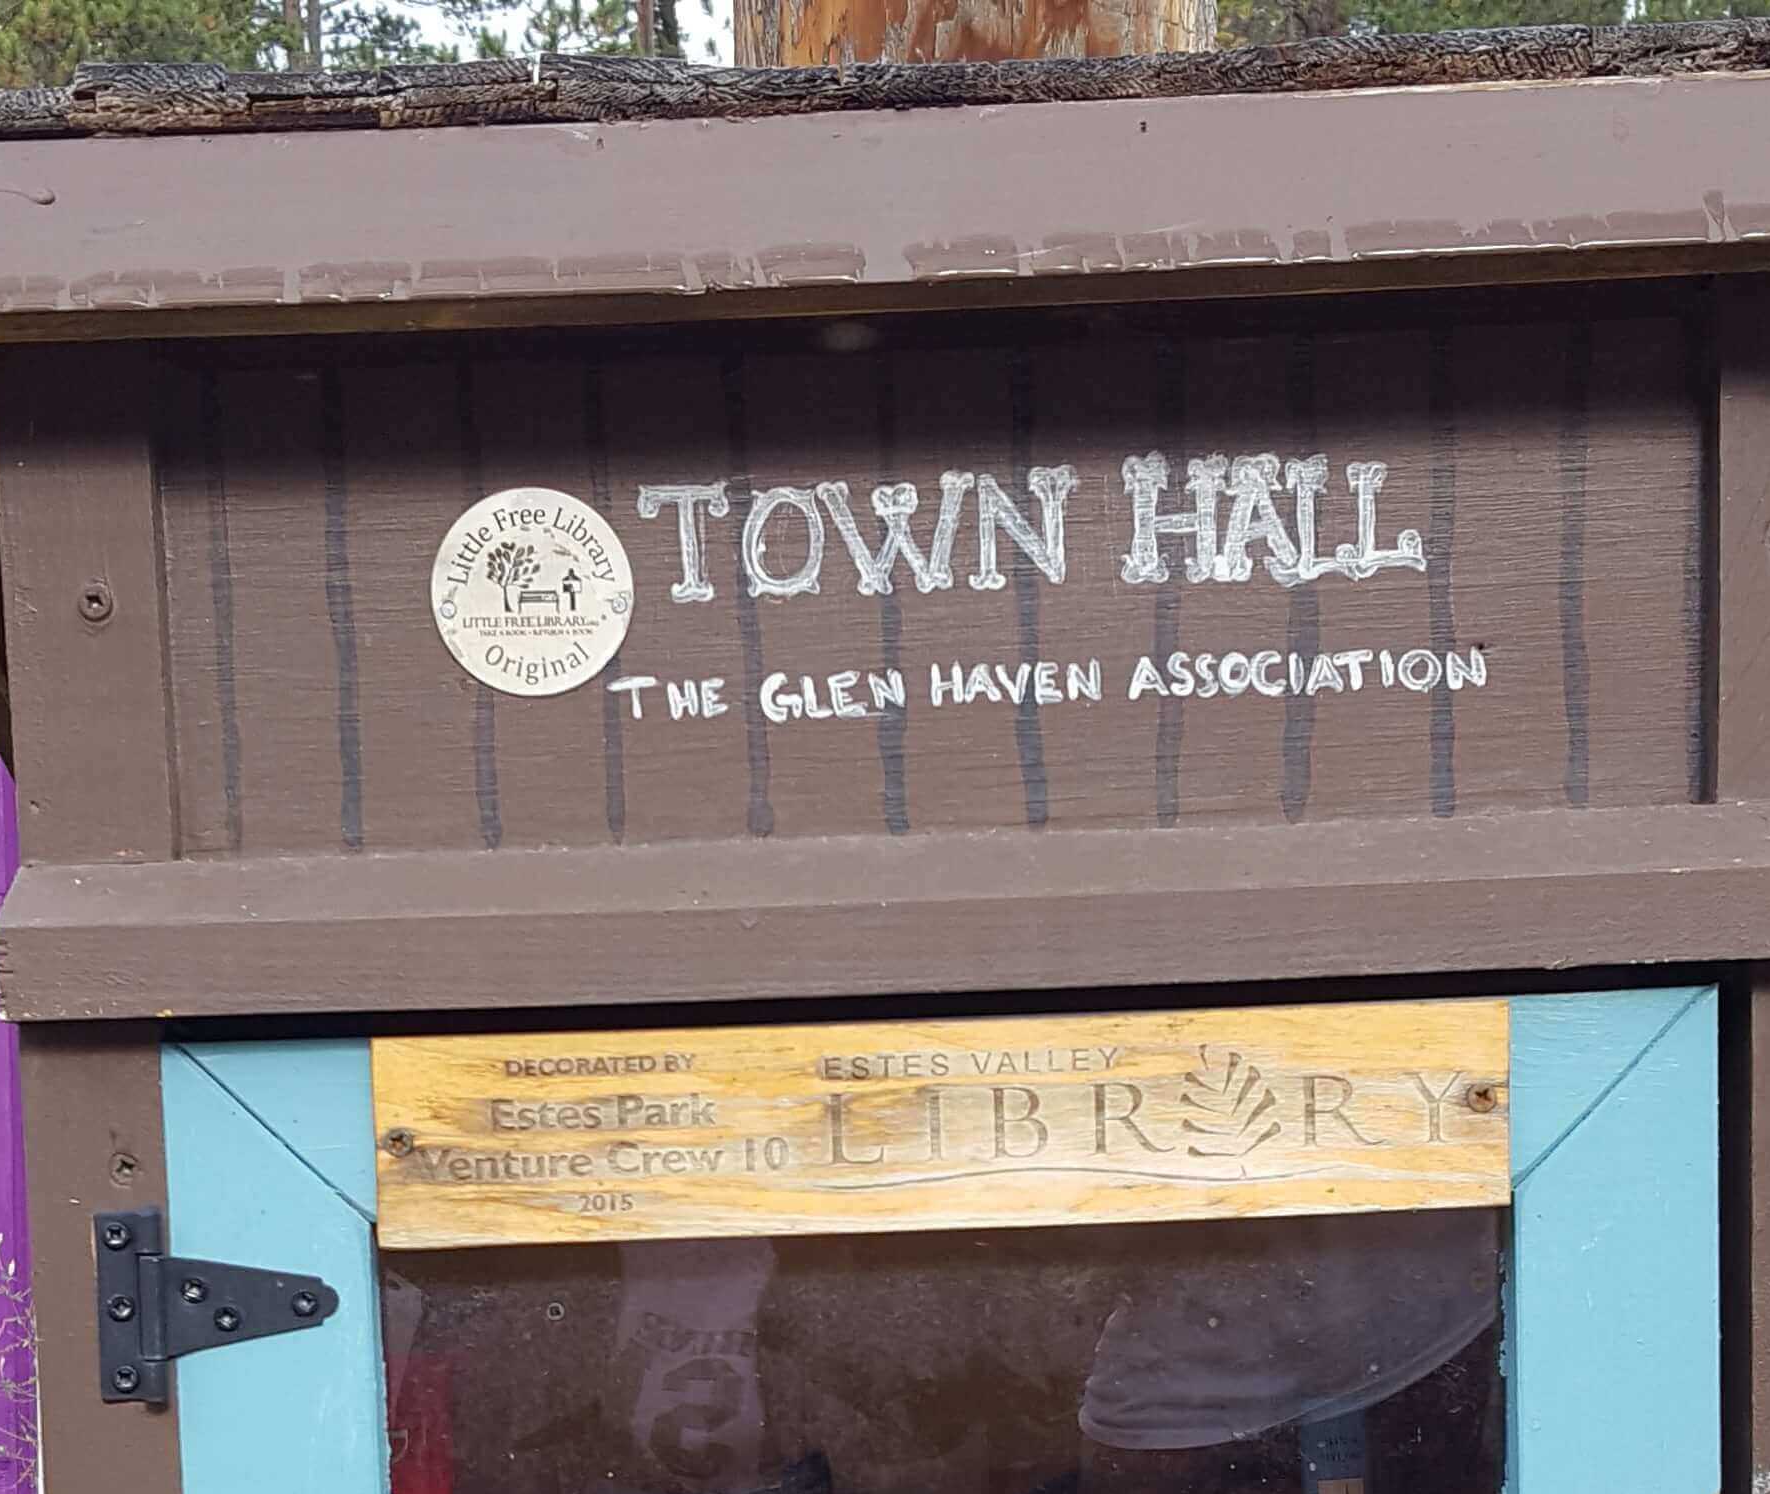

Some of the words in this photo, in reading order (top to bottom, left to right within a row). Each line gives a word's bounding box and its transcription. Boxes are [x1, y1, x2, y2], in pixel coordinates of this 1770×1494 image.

[447, 525, 494, 586] Little
[493, 508, 546, 532] Free
[552, 507, 615, 583] Library
[637, 464, 1078, 603] TOWN
[1121, 450, 1427, 588] HALL
[463, 617, 502, 629] LITTLE
[505, 616, 533, 628] FREE
[485, 641, 589, 685] Original
[607, 676, 729, 720] THE
[760, 669, 906, 722] GLEN
[930, 658, 1102, 707] HAVEN
[1128, 647, 1487, 700] ASSOCIATION
[504, 1055, 656, 1078] DECORATED
[664, 1053, 697, 1072] BY
[823, 1053, 951, 1081] ESTES
[971, 1046, 1119, 1075] VALLEY
[490, 1098, 602, 1132] Estes
[616, 1092, 717, 1129] Park
[828, 1045, 1468, 1166] LIBRRY
[417, 1147, 594, 1182] Venture
[608, 1141, 724, 1174] Crew
[742, 1136, 790, 1172] 10
[578, 1192, 634, 1213] 2015
